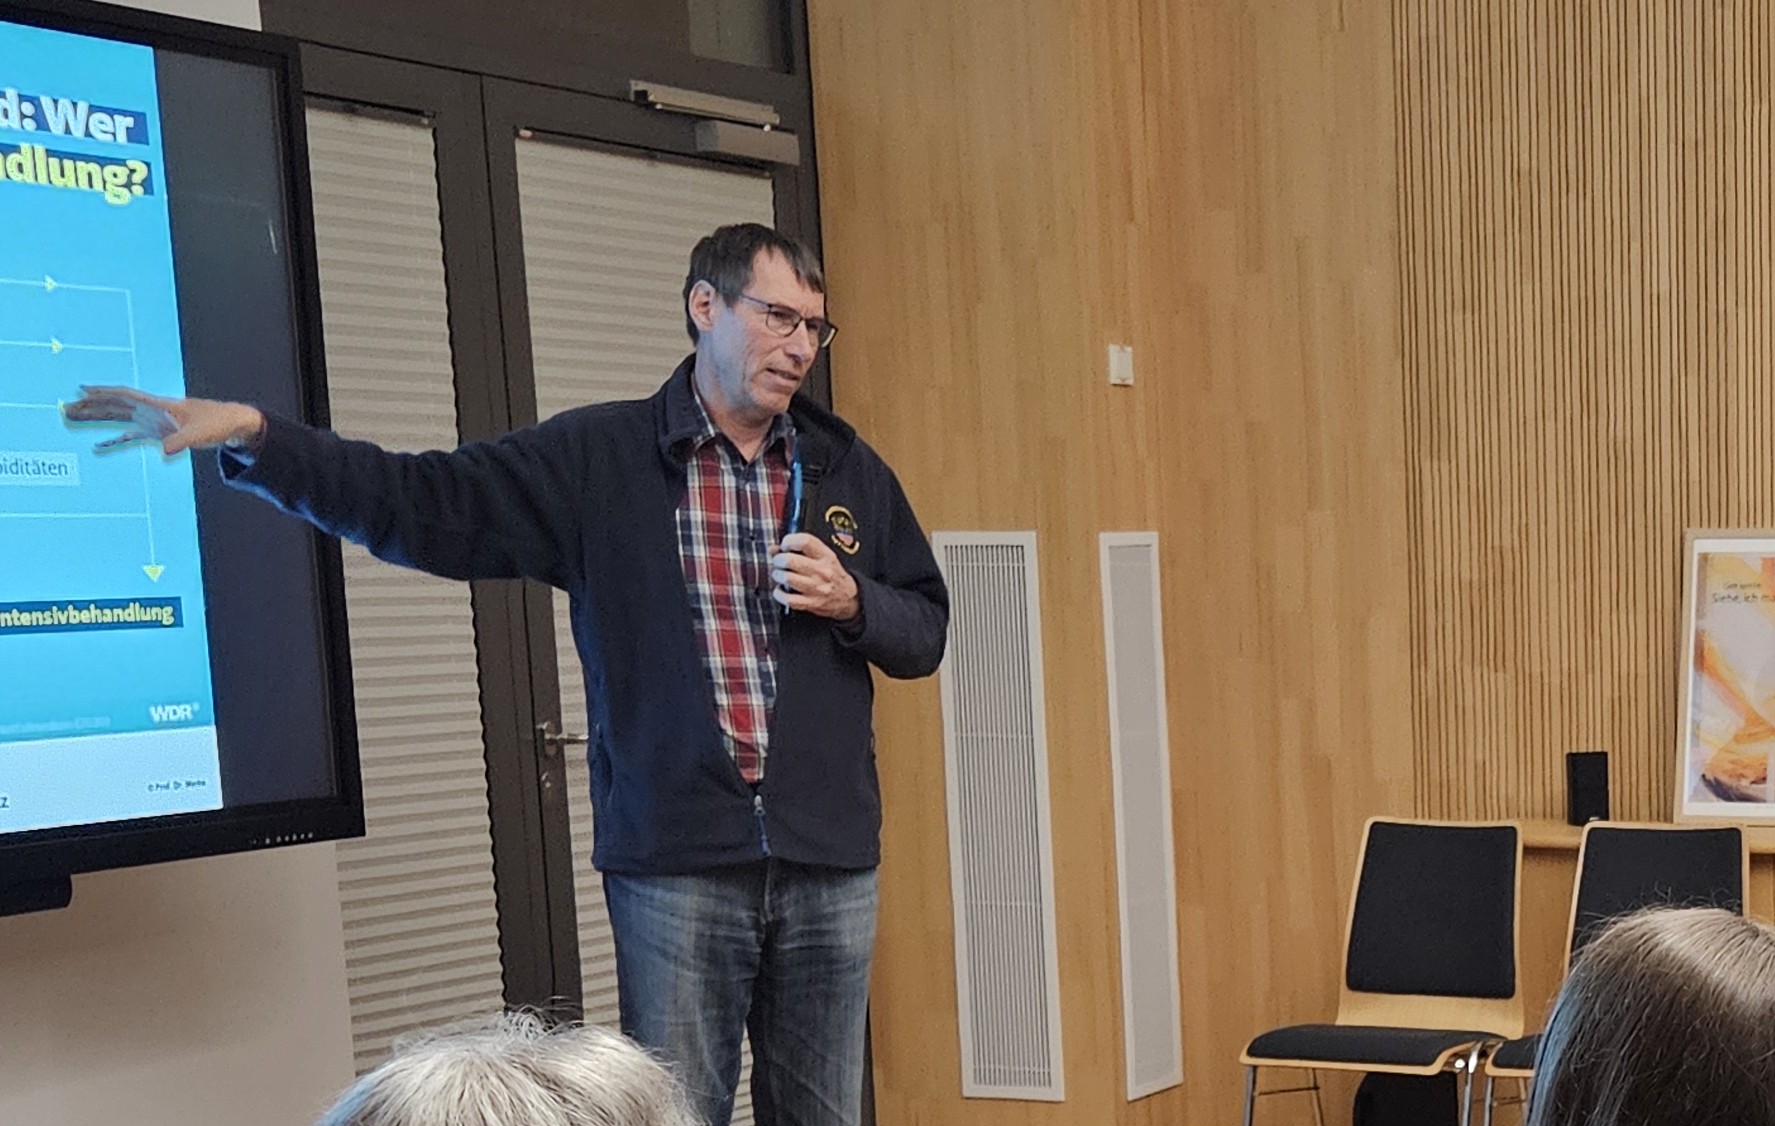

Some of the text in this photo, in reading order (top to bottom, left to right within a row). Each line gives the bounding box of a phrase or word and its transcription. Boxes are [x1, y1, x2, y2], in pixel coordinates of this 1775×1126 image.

[40, 94, 135, 144] Wer
[0, 142, 149, 205] dlung?
[0, 457, 68, 476] iditäten
[0, 602, 175, 628] ntensivbehandlung
[149, 704, 194, 723] WDR
